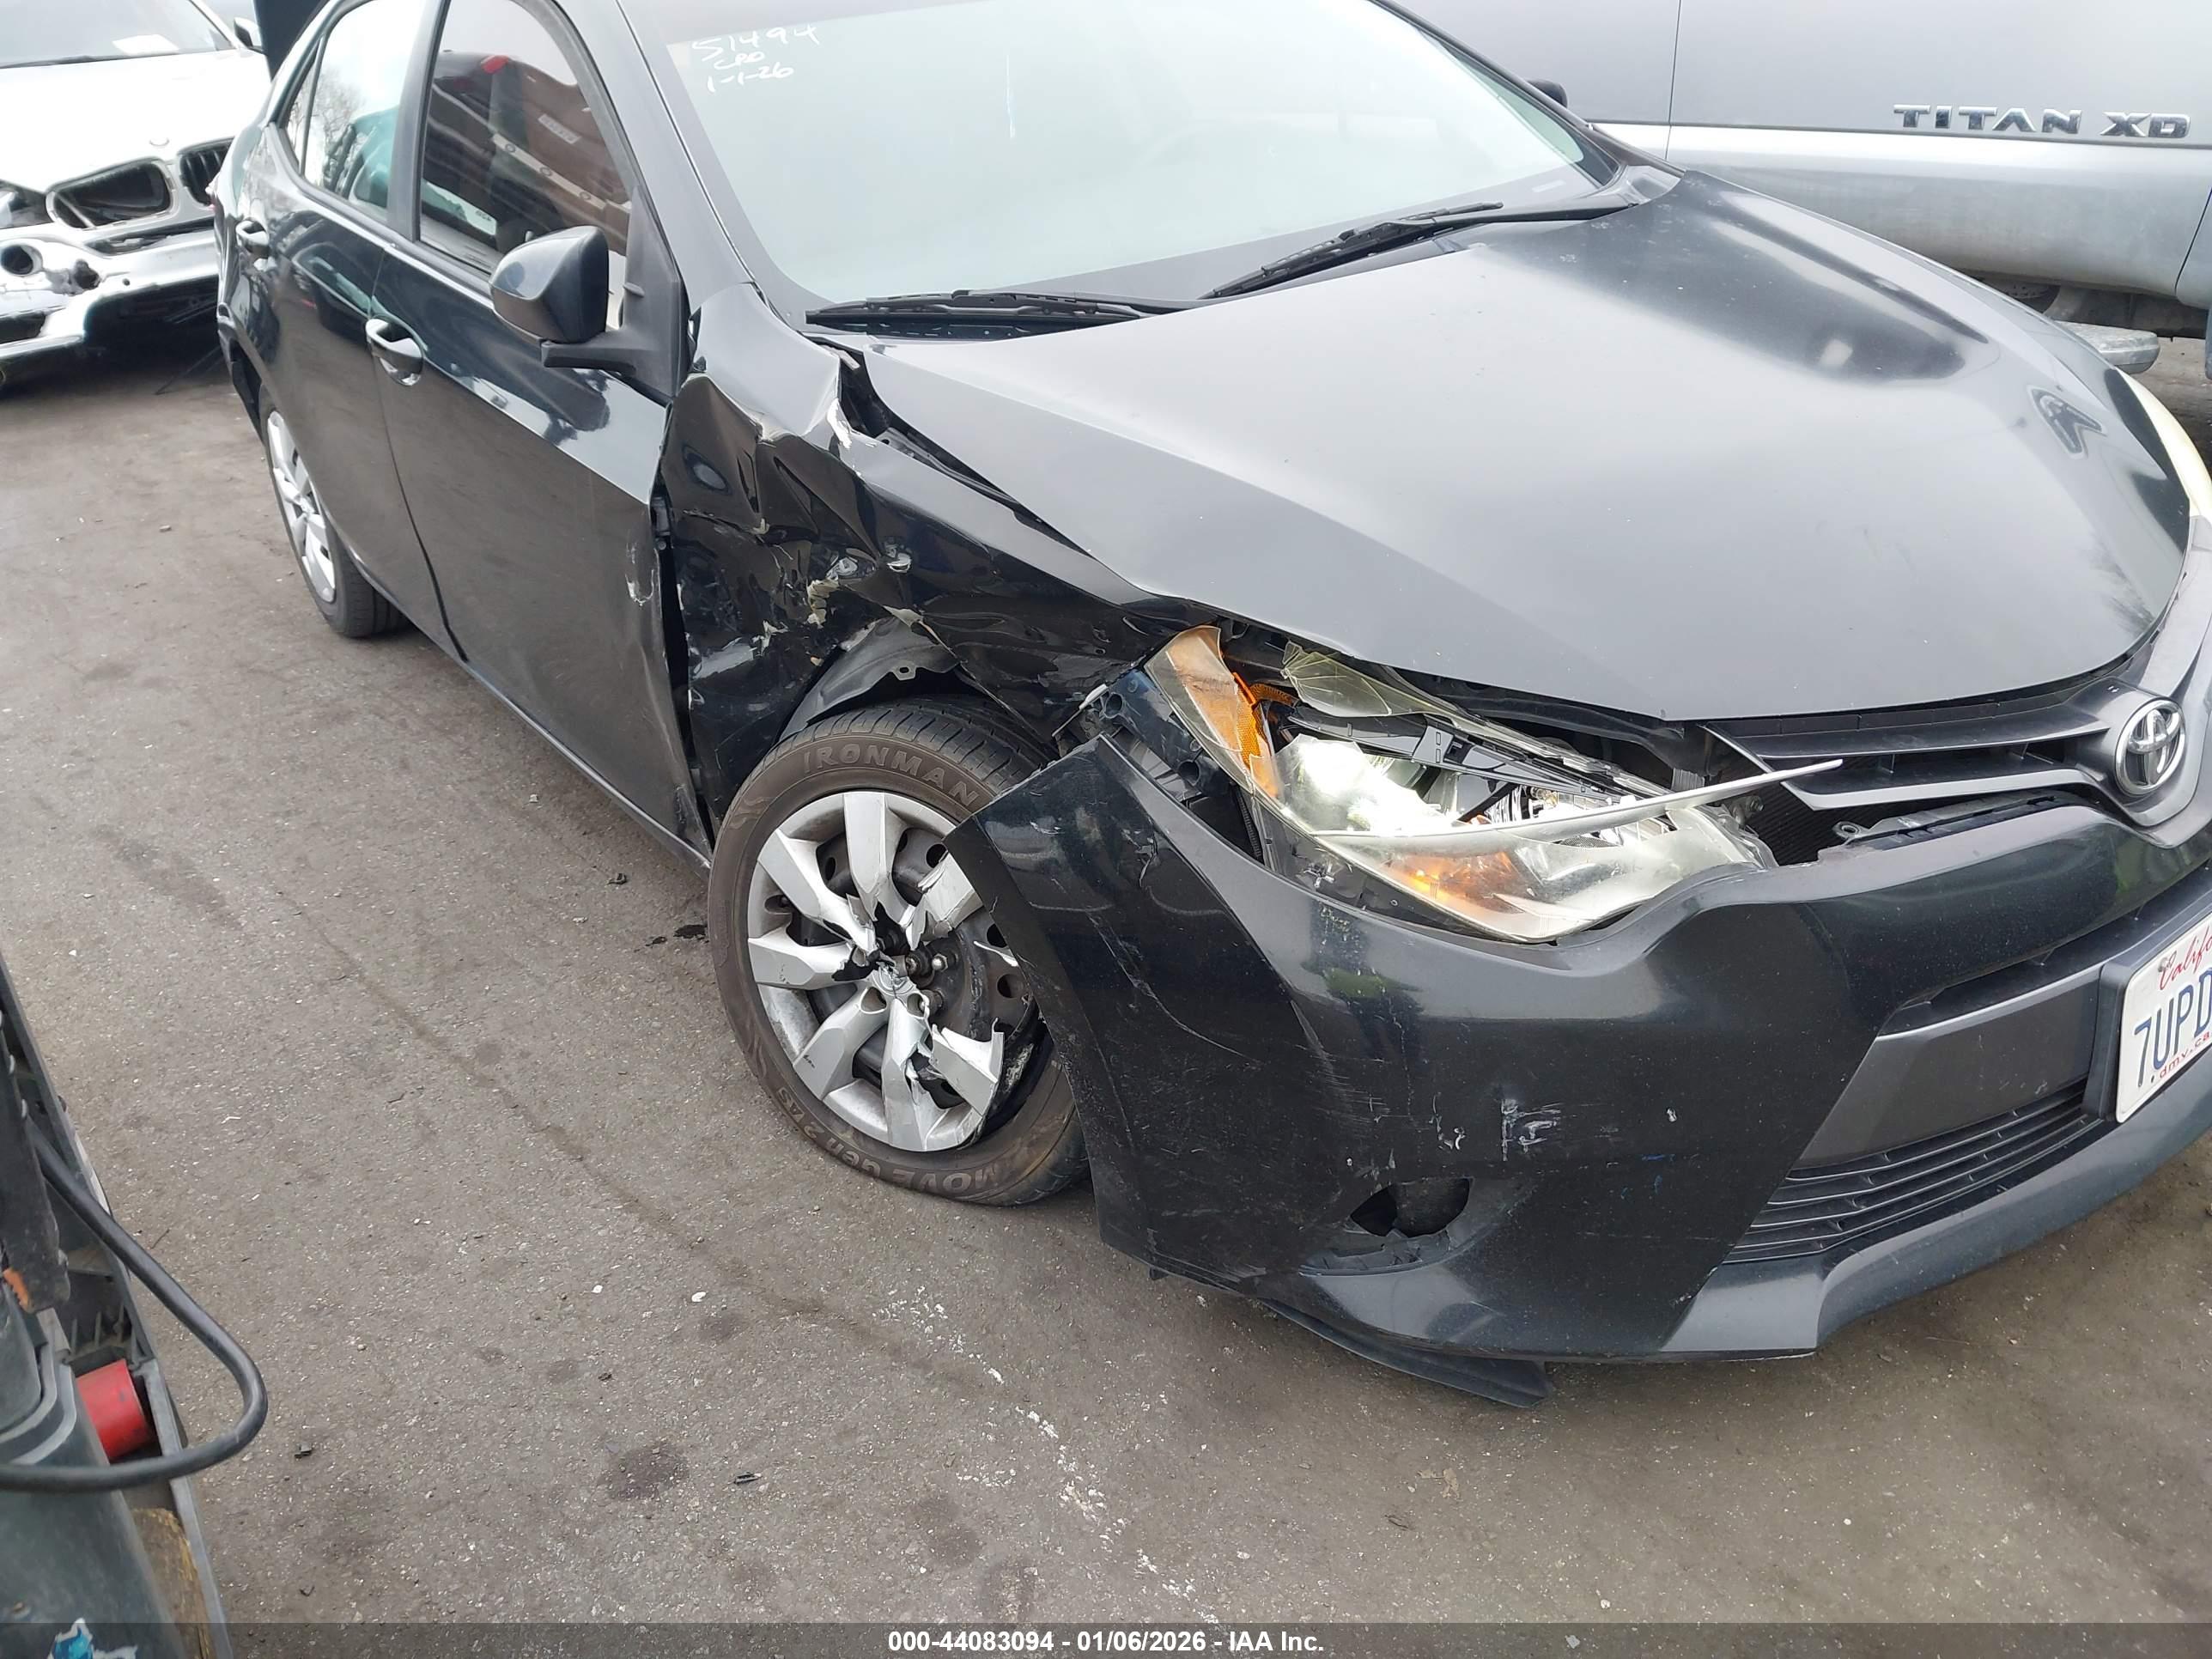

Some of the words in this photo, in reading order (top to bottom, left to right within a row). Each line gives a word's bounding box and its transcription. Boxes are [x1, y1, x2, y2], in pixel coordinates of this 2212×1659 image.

[1893, 104, 2082, 134] TITAN
[2100, 111, 2191, 138] XD
[804, 744, 979, 806] IRONMAN
